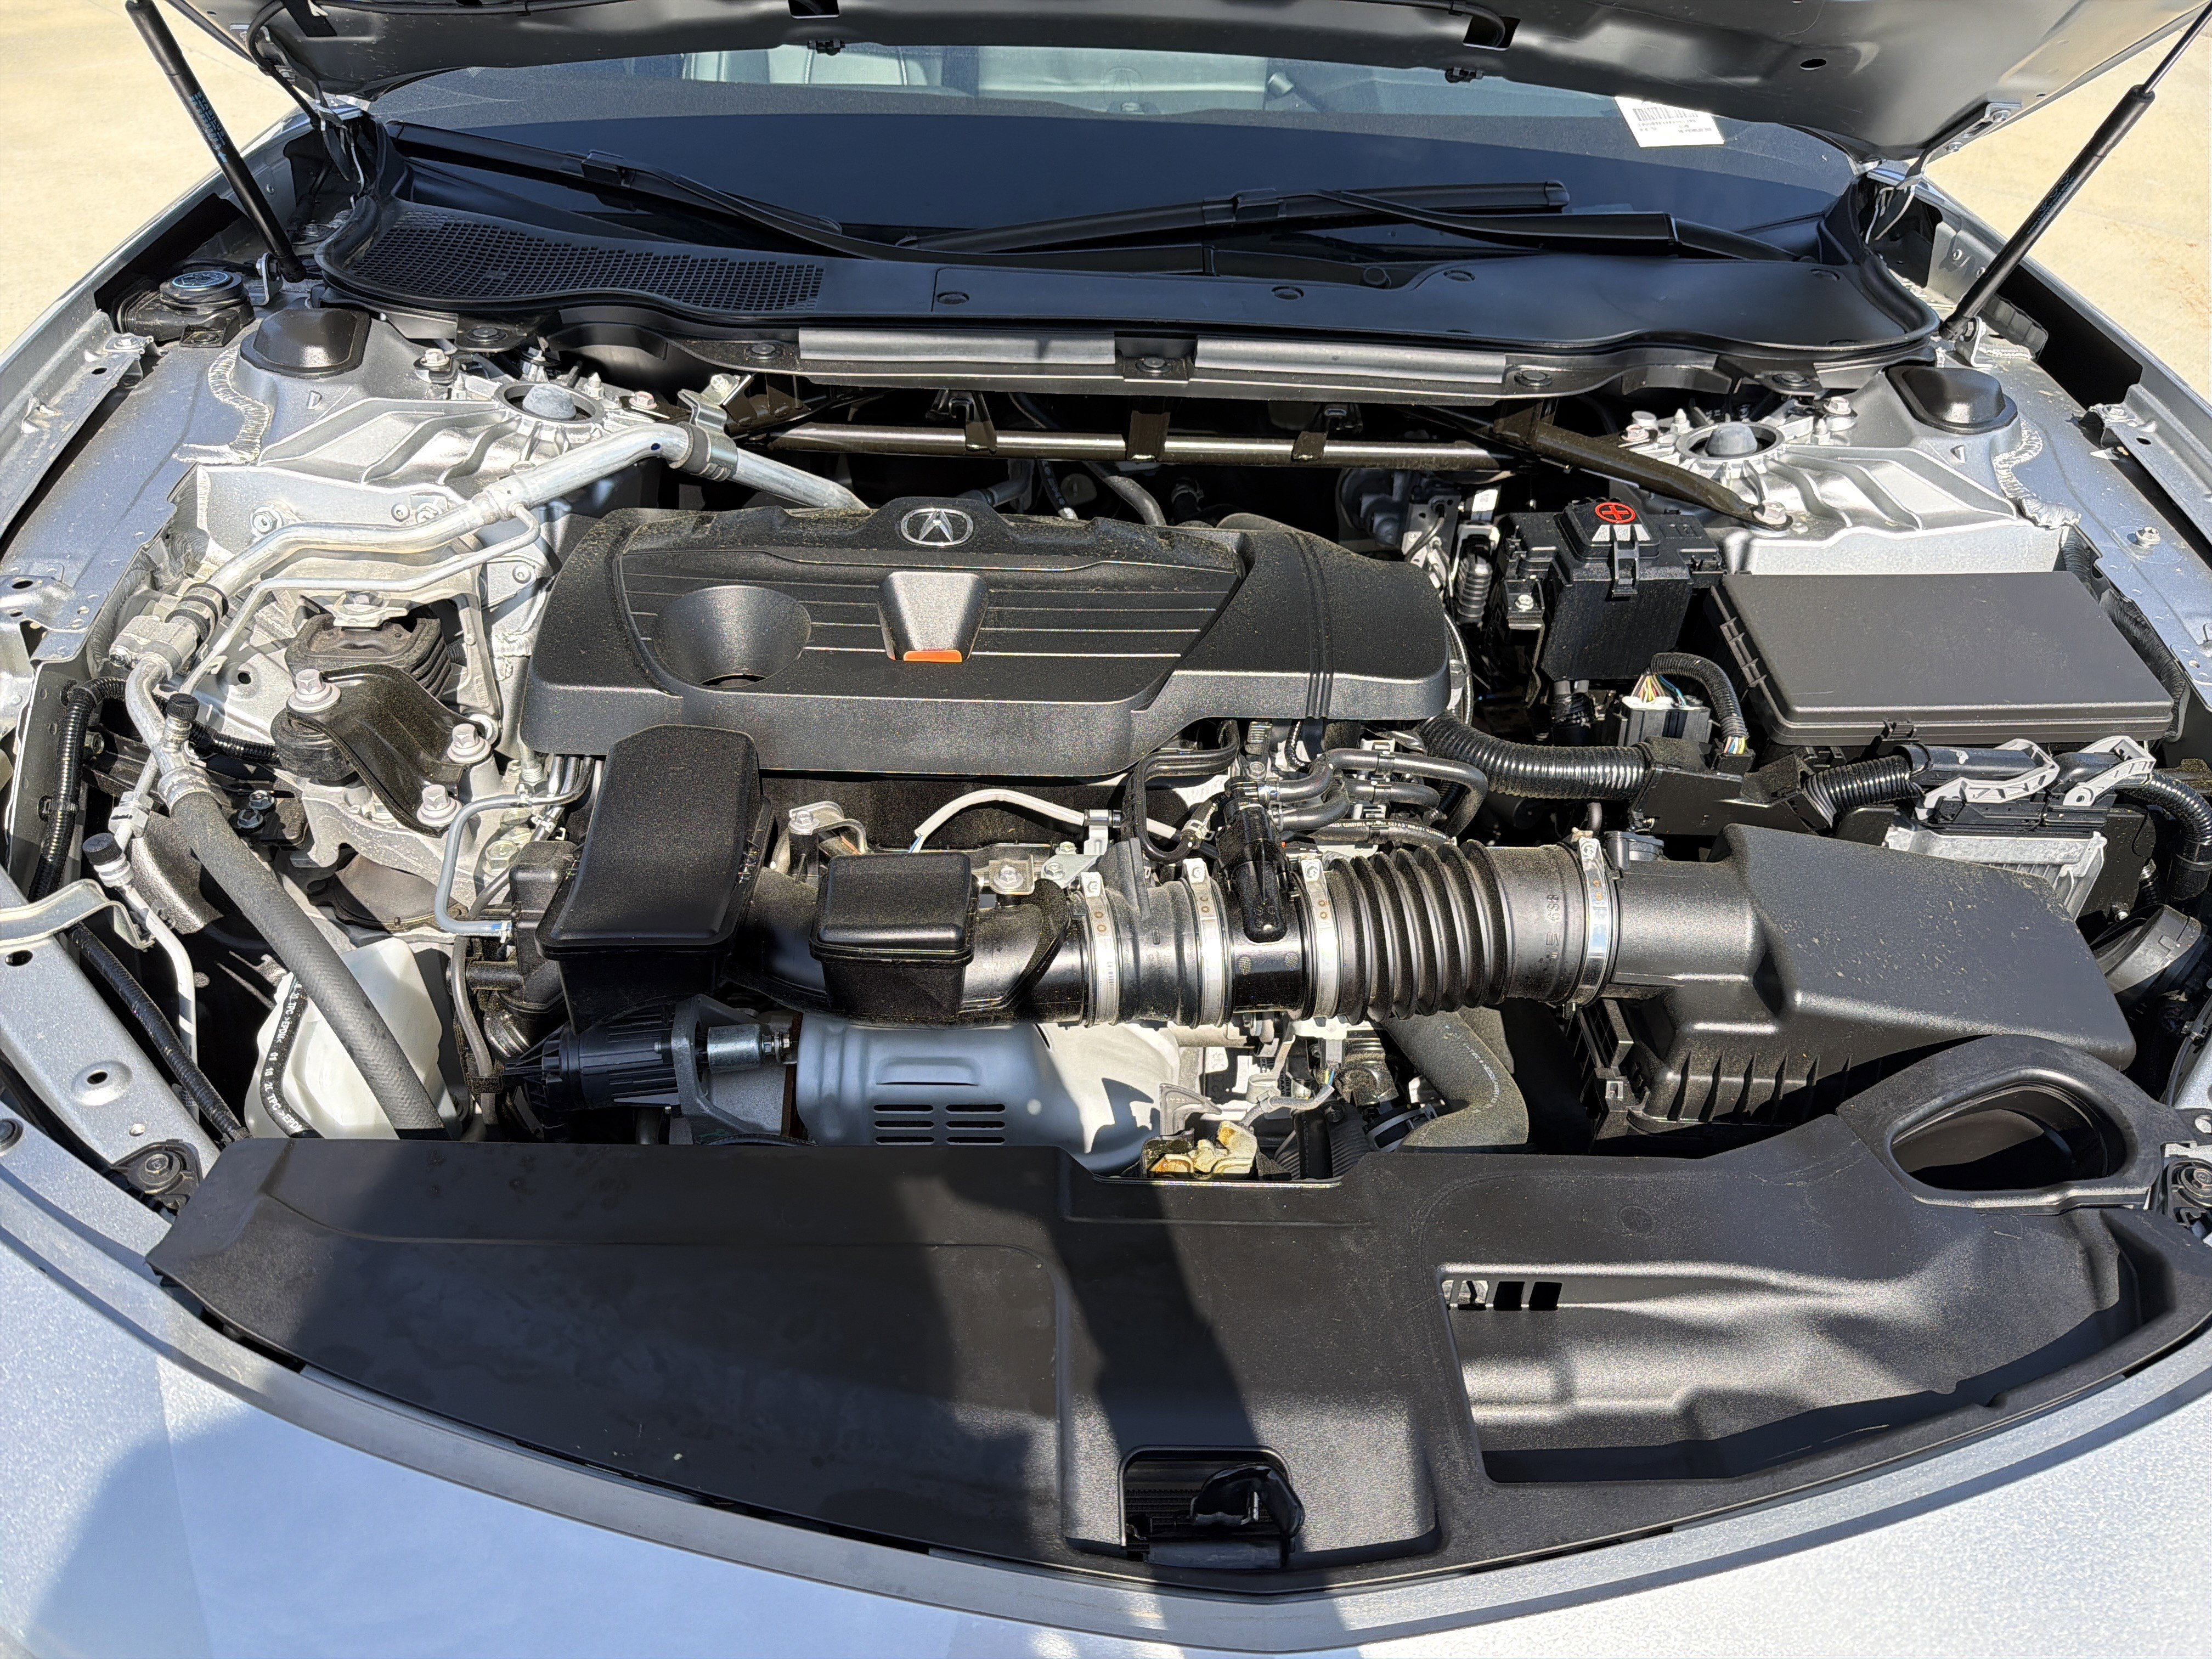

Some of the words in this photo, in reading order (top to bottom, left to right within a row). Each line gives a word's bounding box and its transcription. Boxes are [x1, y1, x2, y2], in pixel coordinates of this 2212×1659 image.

[269, 1052, 279, 1061] 01
[265, 1067, 274, 1077] 10
[267, 1093, 281, 1111] TPC
